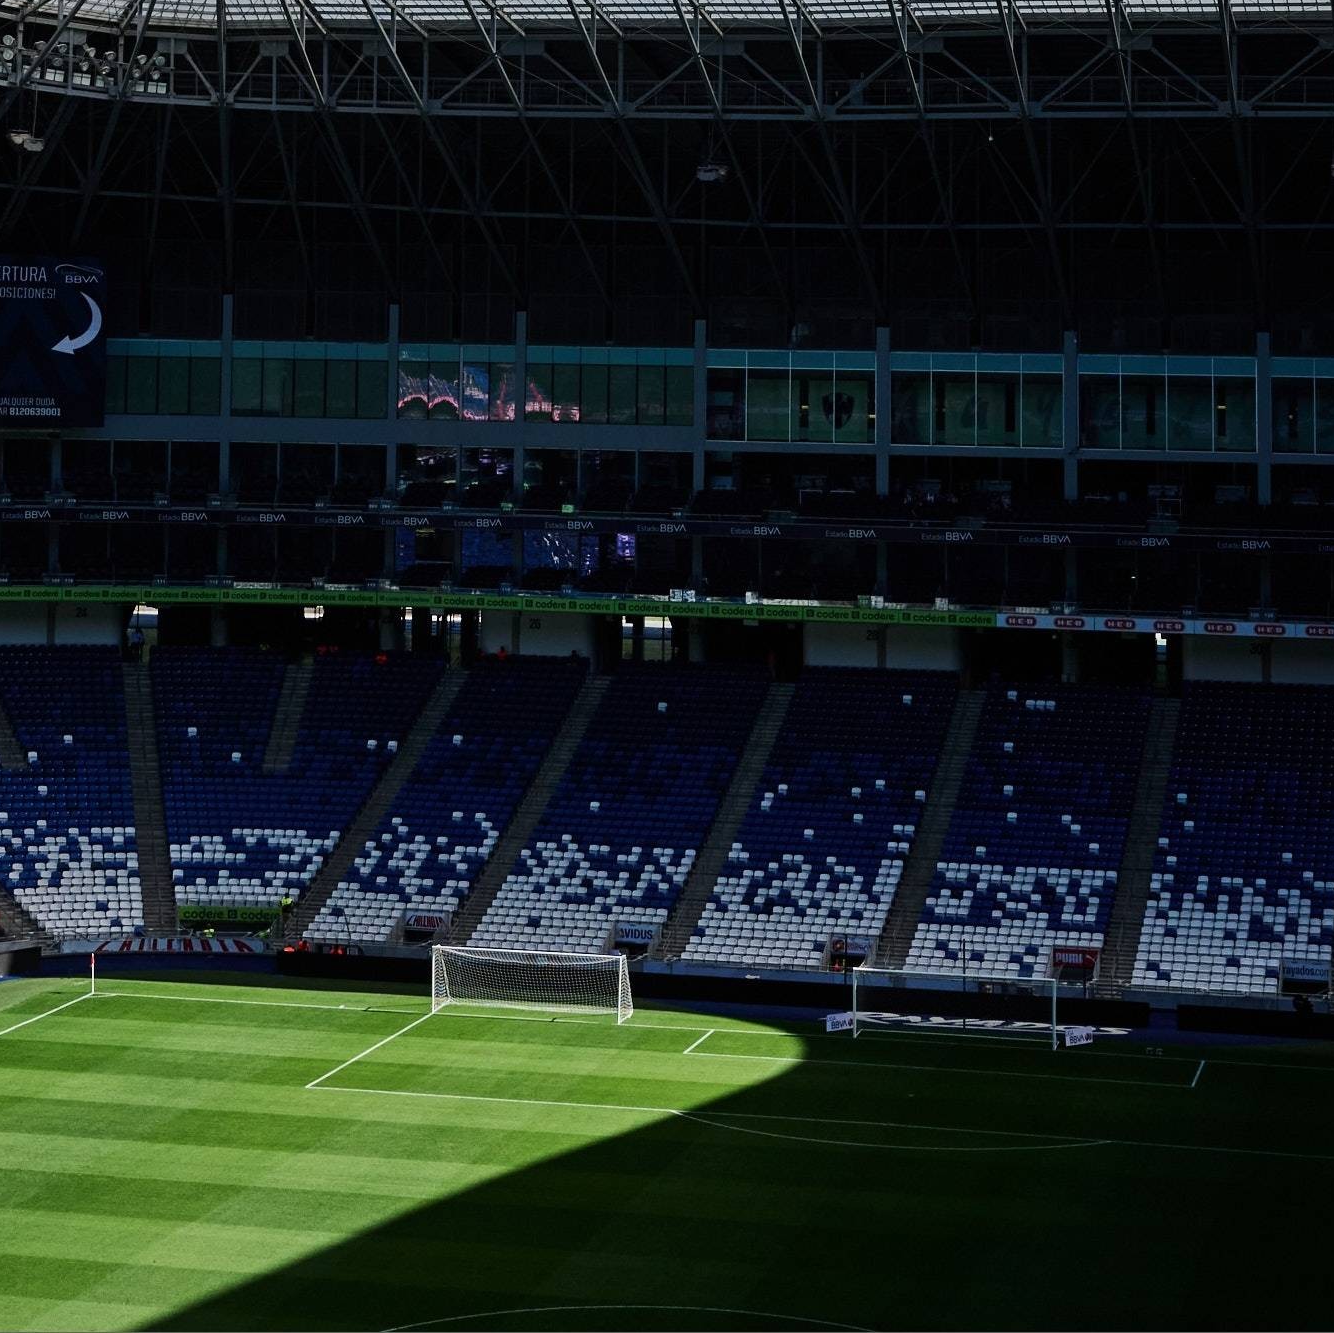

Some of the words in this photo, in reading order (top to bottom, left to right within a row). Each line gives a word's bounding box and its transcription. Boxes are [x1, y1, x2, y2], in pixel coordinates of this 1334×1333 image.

[65, 274, 99, 284] BBVA
[103, 511, 130, 520] BBVA
[659, 523, 686, 533] BBVA
[1042, 535, 1071, 544] BBVA
[721, 606, 753, 617] codere
[766, 608, 798, 618] codere
[183, 909, 224, 920] codere
